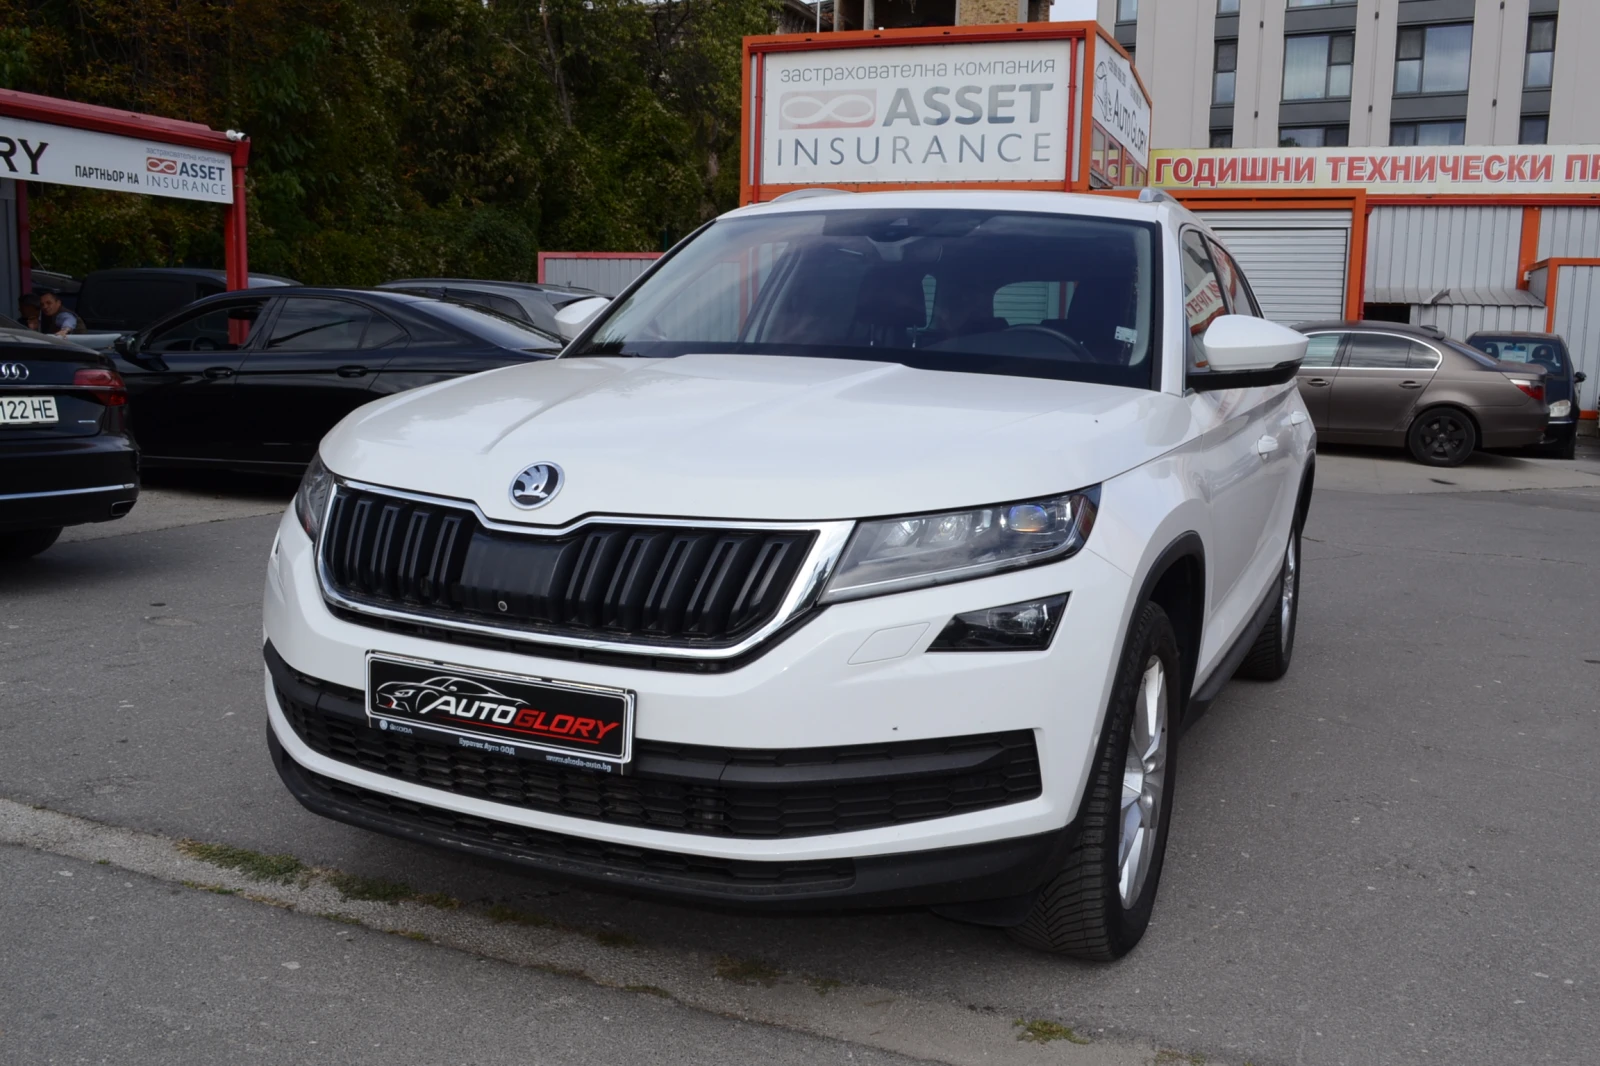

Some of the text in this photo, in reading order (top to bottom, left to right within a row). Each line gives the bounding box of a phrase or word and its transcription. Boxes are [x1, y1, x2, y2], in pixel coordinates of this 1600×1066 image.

[781, 58, 1055, 85] застрахователна компания
[882, 83, 1054, 127] ASSET
[777, 133, 1051, 166] INSURANCE
[75, 165, 139, 184] ПАРТНЬОР НА
[179, 162, 225, 181] ASSET
[1155, 156, 1315, 187] ГОДИШНИ
[1326, 154, 1553, 182] ТЕХНИЧЕСКИ
[146, 175, 226, 195] INSURANCE
